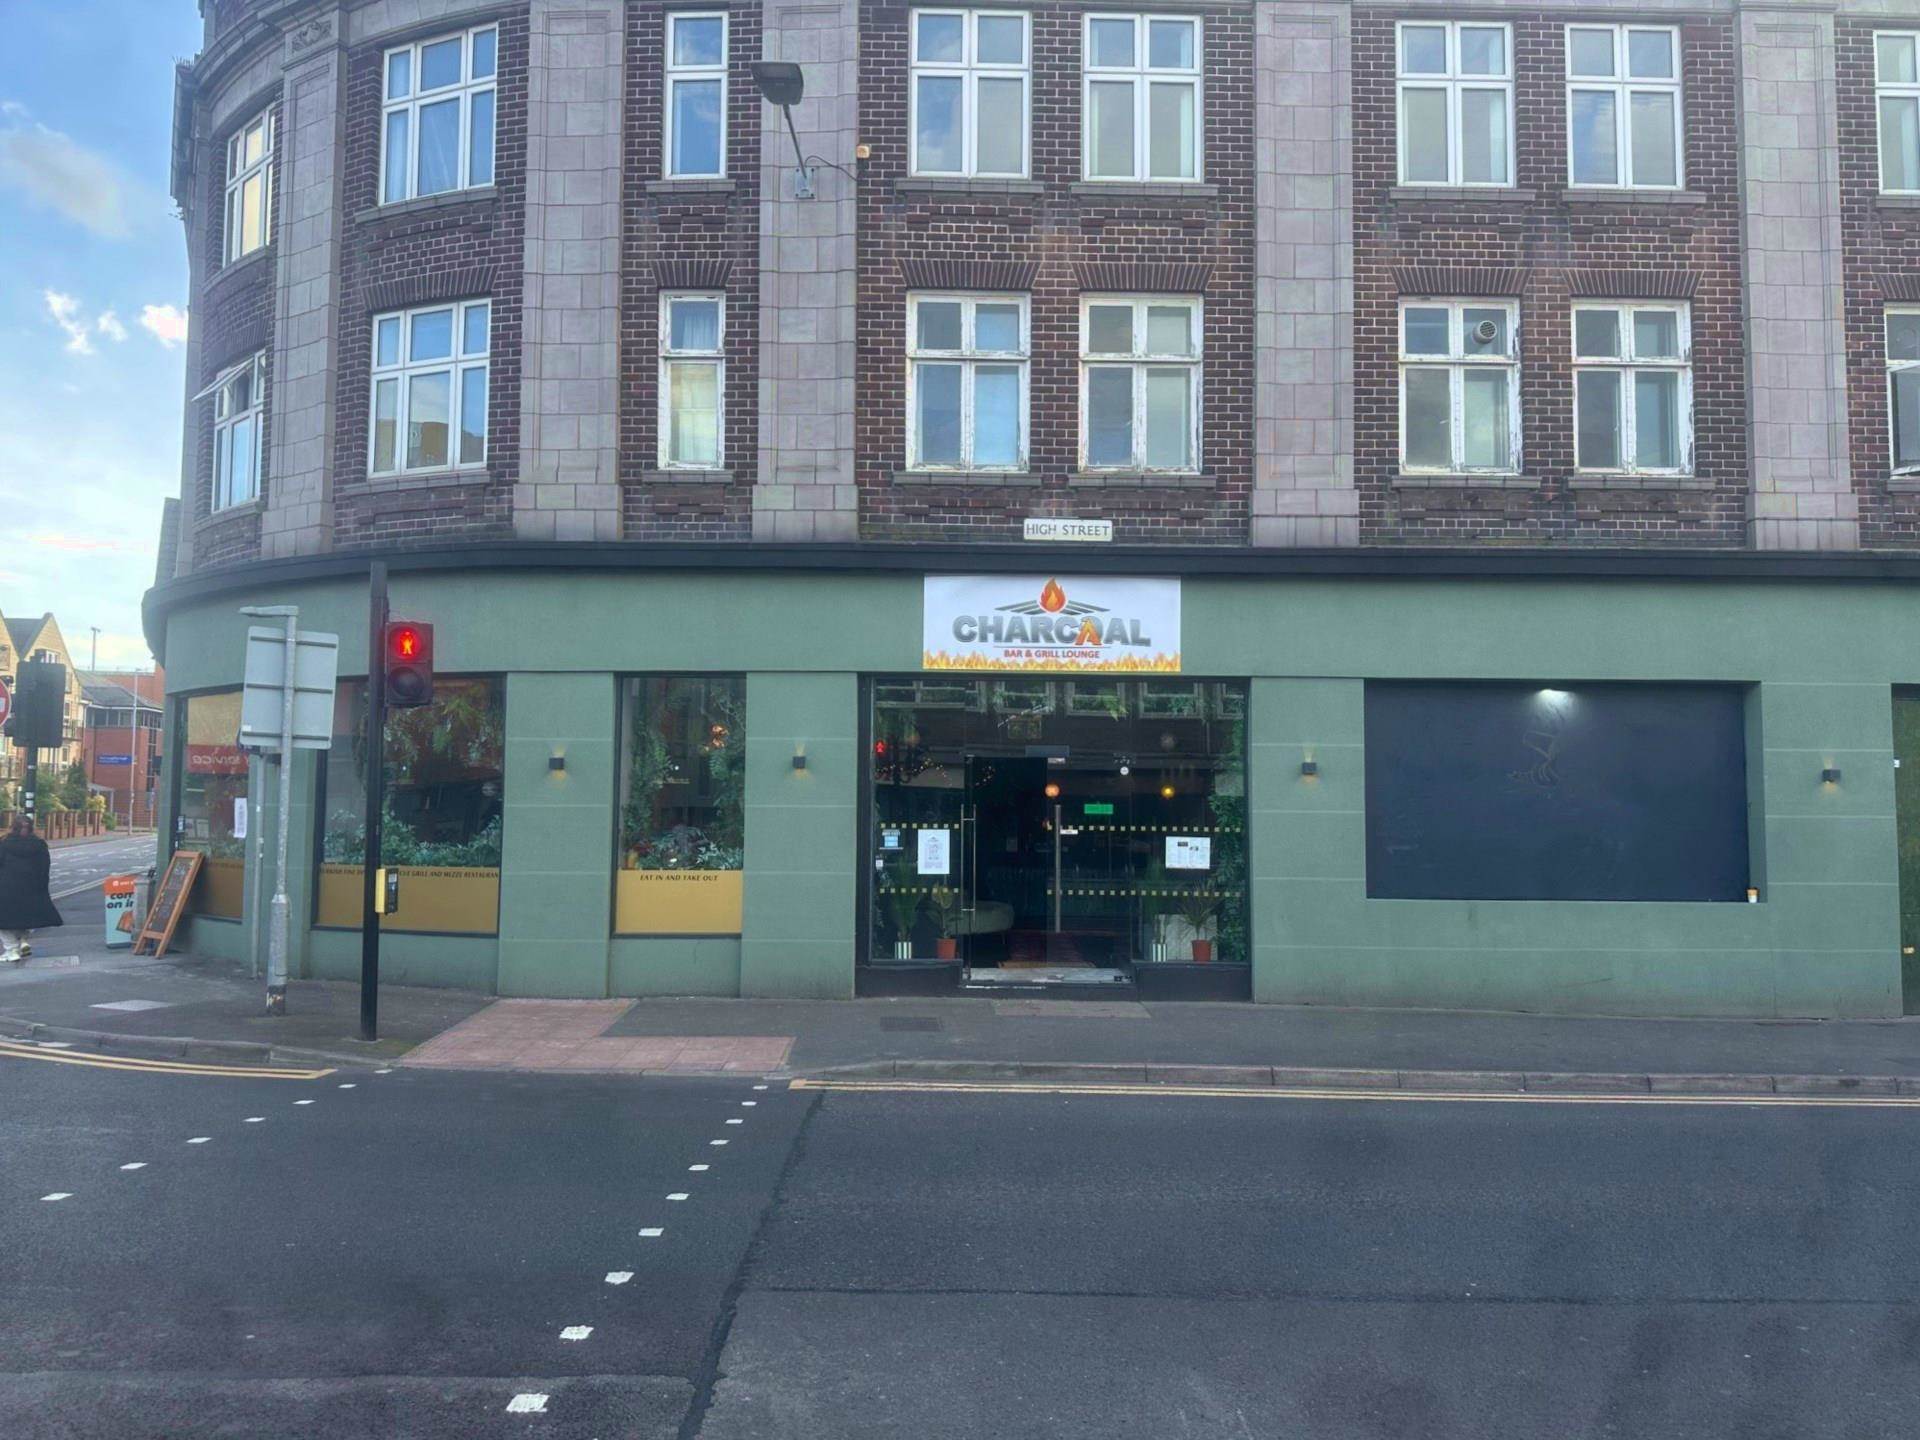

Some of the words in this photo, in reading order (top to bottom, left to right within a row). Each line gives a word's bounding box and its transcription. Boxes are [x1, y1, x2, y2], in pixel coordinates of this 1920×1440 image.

[1026, 523, 1057, 535] HIGH
[1062, 524, 1110, 536] STREET
[952, 615, 1151, 647] CHARCOAL
[1004, 649, 1023, 658] BAR
[1025, 649, 1033, 658] &
[1034, 649, 1060, 659] GRILL
[1062, 650, 1100, 659] LOUNGE
[430, 870, 442, 878] AND
[464, 871, 499, 879] RESTAURAN
[702, 874, 719, 882] OUT
[106, 901, 123, 909] on
